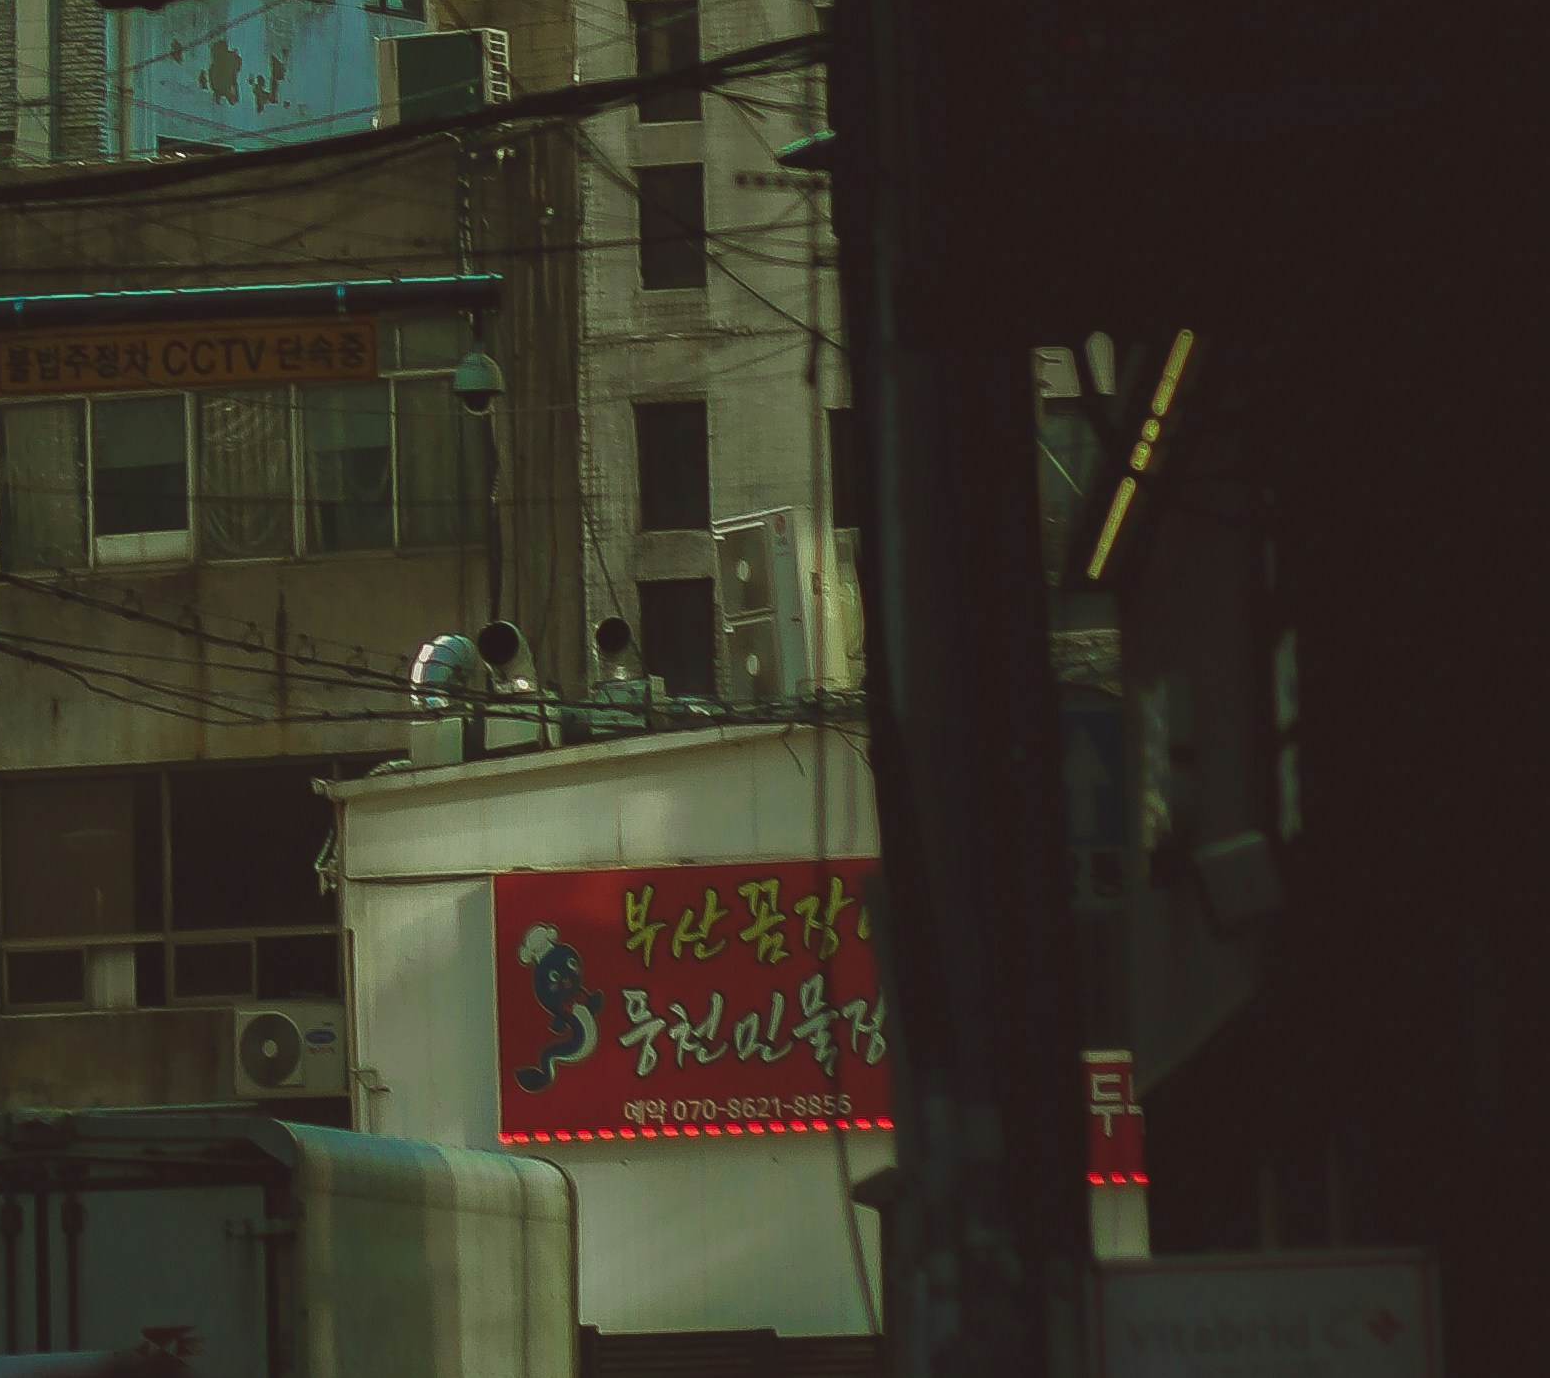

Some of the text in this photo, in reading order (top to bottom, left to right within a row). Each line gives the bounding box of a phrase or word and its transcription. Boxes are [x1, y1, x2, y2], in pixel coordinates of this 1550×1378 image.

[6, 331, 366, 385] 불법주정차 CCTV 단속중
[624, 1098, 667, 1125] 예약
